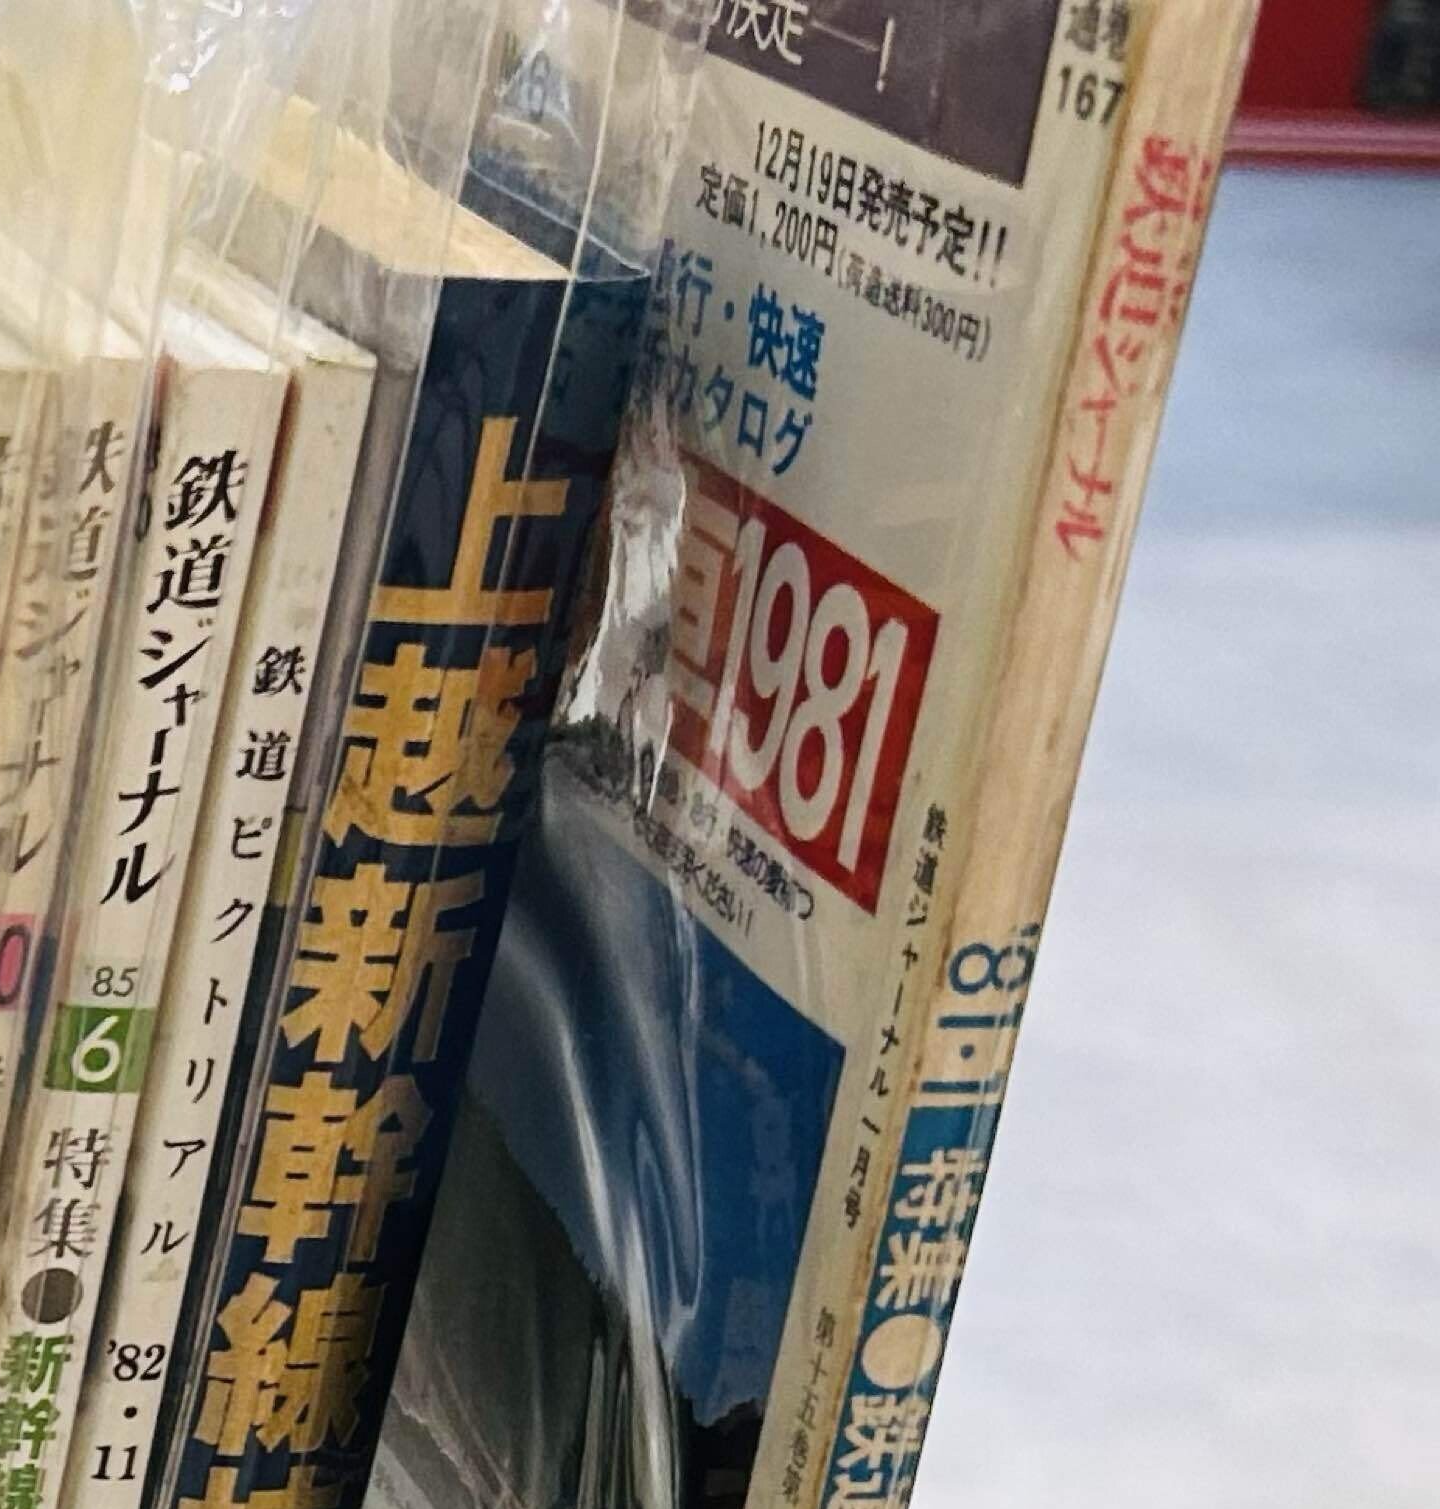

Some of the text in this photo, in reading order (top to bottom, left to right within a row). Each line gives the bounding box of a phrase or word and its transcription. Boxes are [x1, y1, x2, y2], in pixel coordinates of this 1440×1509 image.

[1057, 65, 1126, 126] 167
[99, 448, 248, 905] 鉄道ジャーナル
[69, 1013, 121, 1083] 6
[141, 645, 309, 1256] 鉄道ピクトリアル
